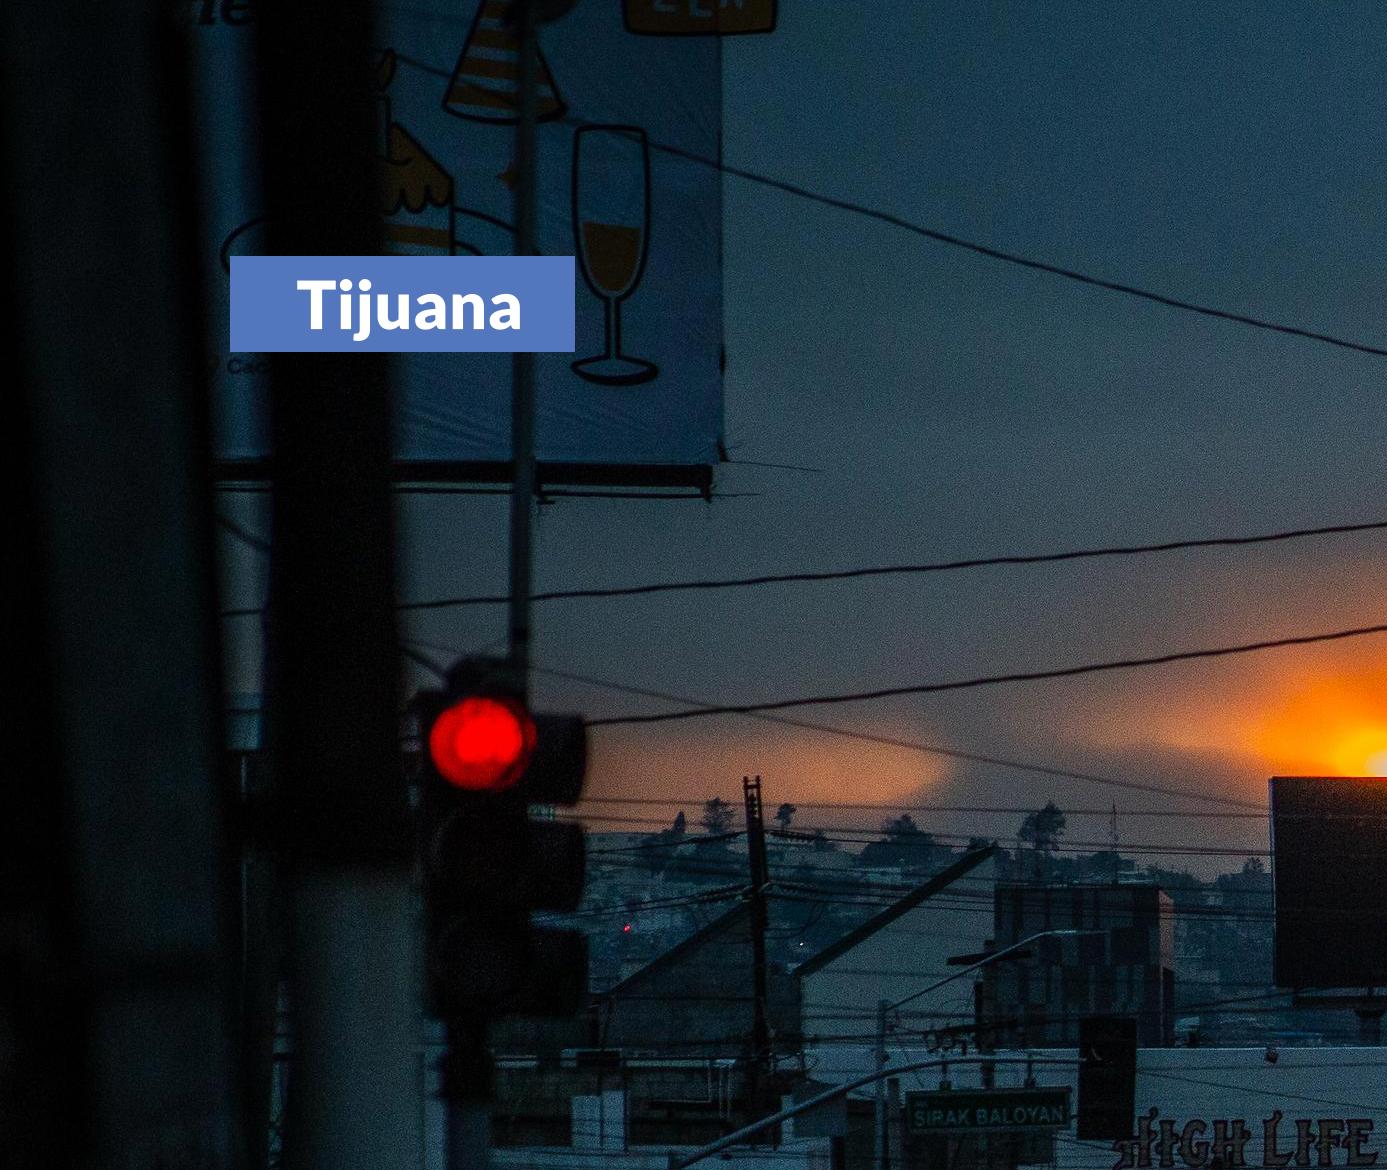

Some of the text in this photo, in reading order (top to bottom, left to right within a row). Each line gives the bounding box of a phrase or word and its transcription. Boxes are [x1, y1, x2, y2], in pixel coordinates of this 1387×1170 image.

[913, 1104, 1066, 1127] SIRAK BALOYAN
[1262, 1109, 1379, 1170] LIFE
